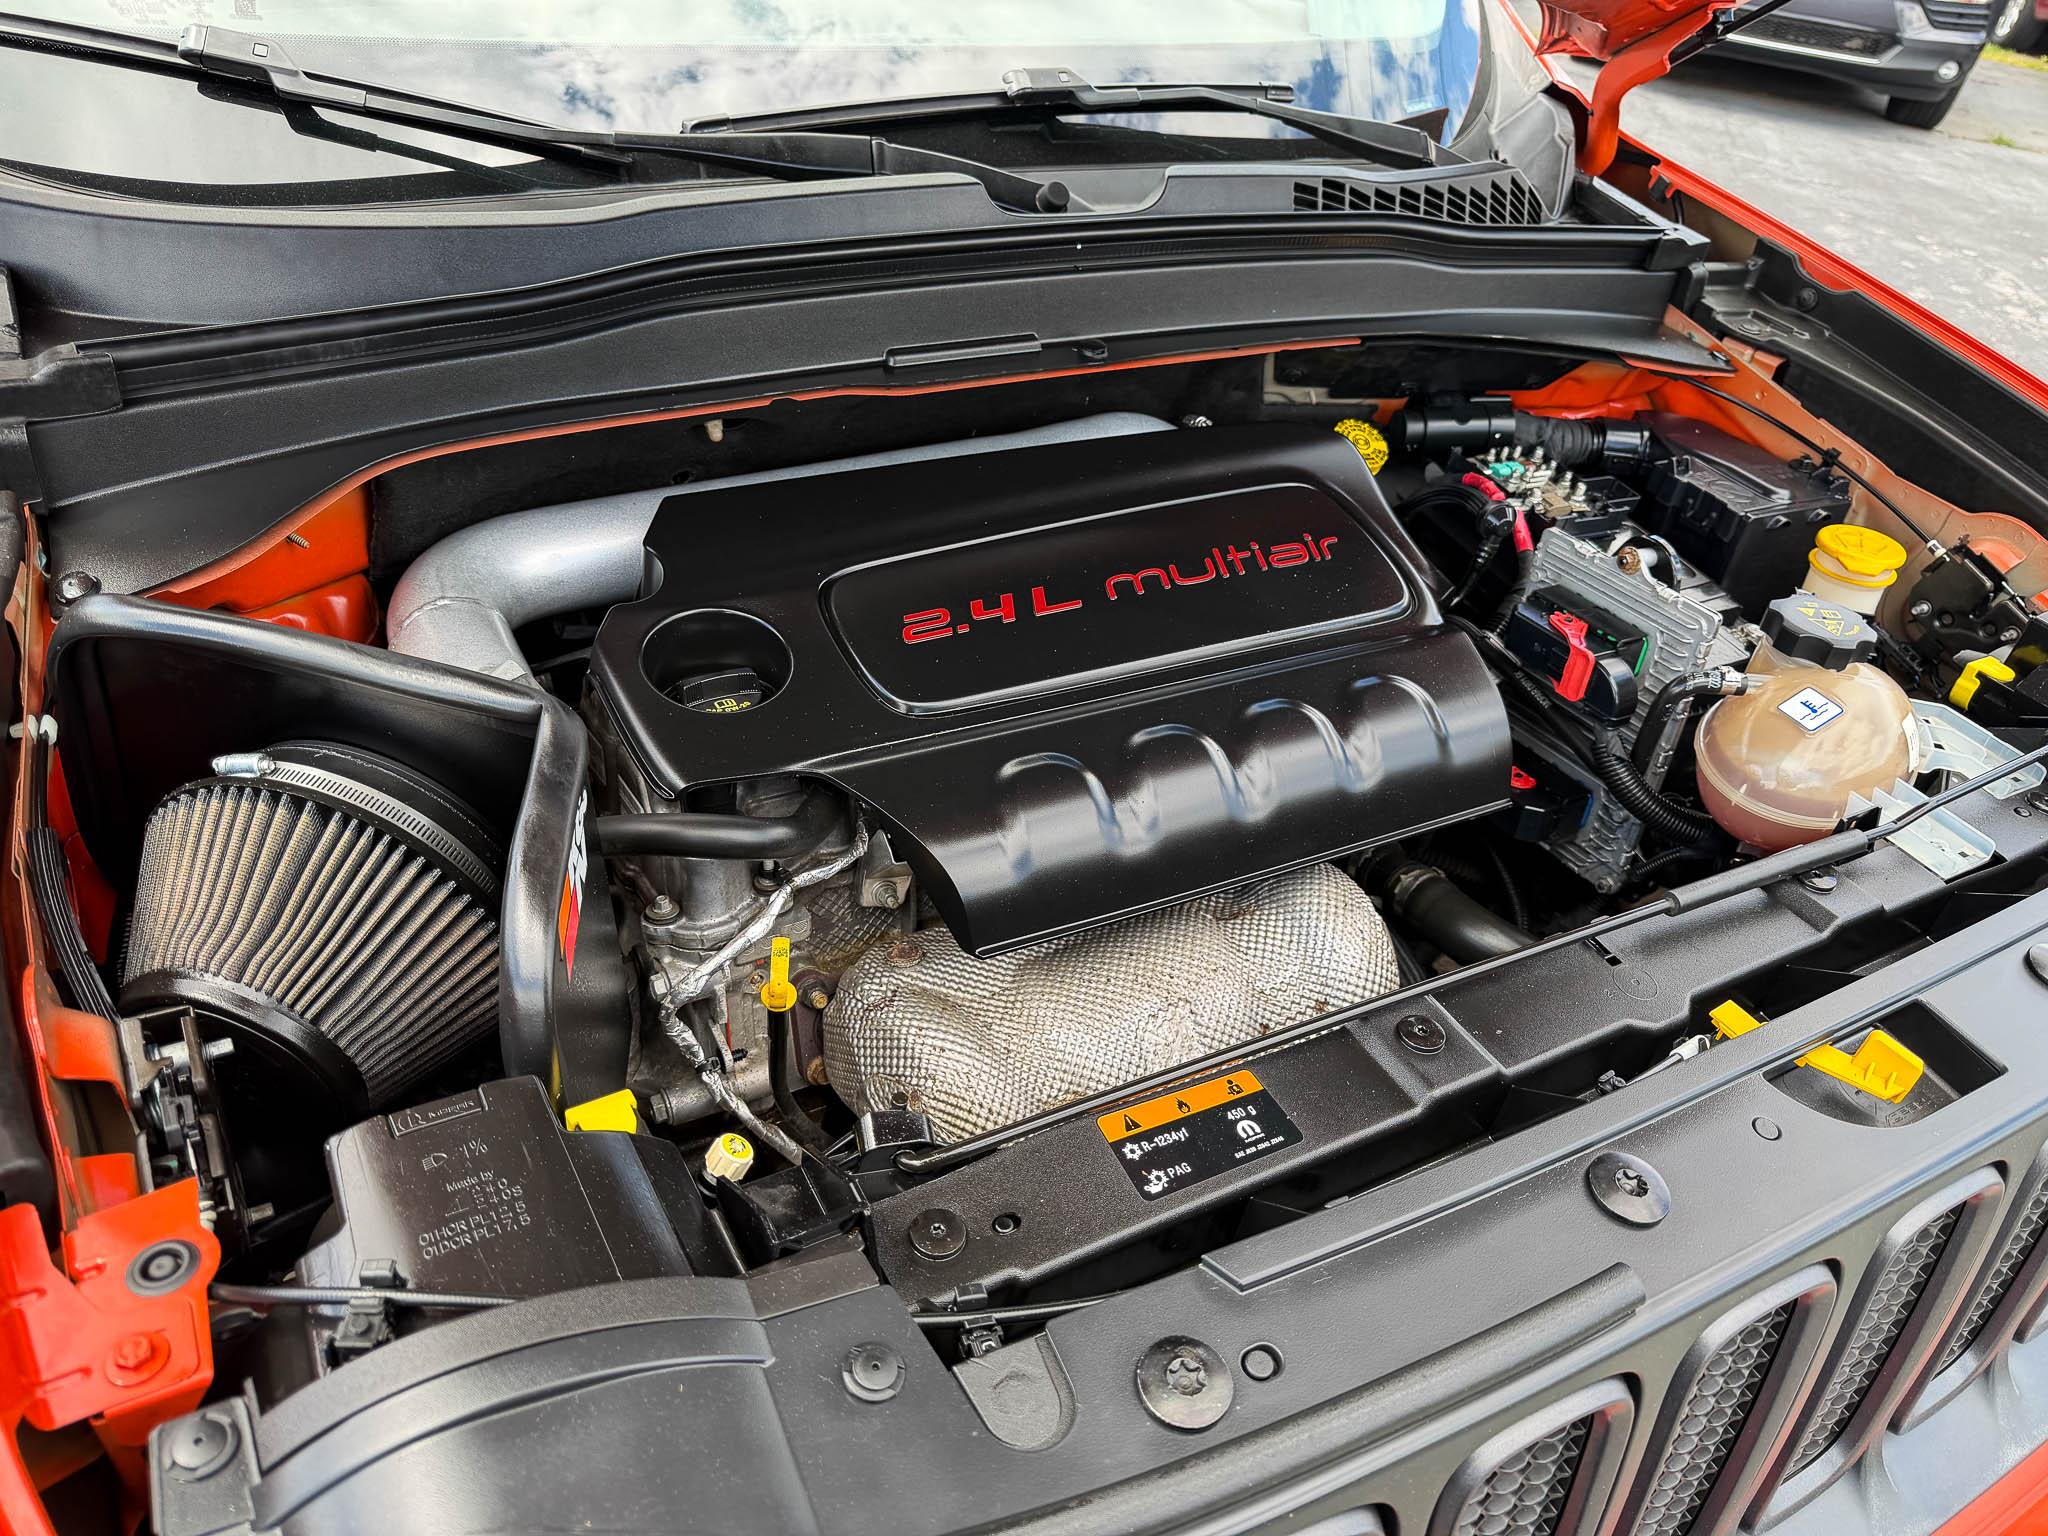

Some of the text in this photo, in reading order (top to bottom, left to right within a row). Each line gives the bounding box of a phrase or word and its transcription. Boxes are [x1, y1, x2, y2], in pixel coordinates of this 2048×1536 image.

[903, 533, 1338, 645] 2.4 L multiair
[1227, 1105, 1257, 1121] 450 g
[1167, 1162, 1192, 1179] PAG
[446, 1176, 479, 1192] Made
